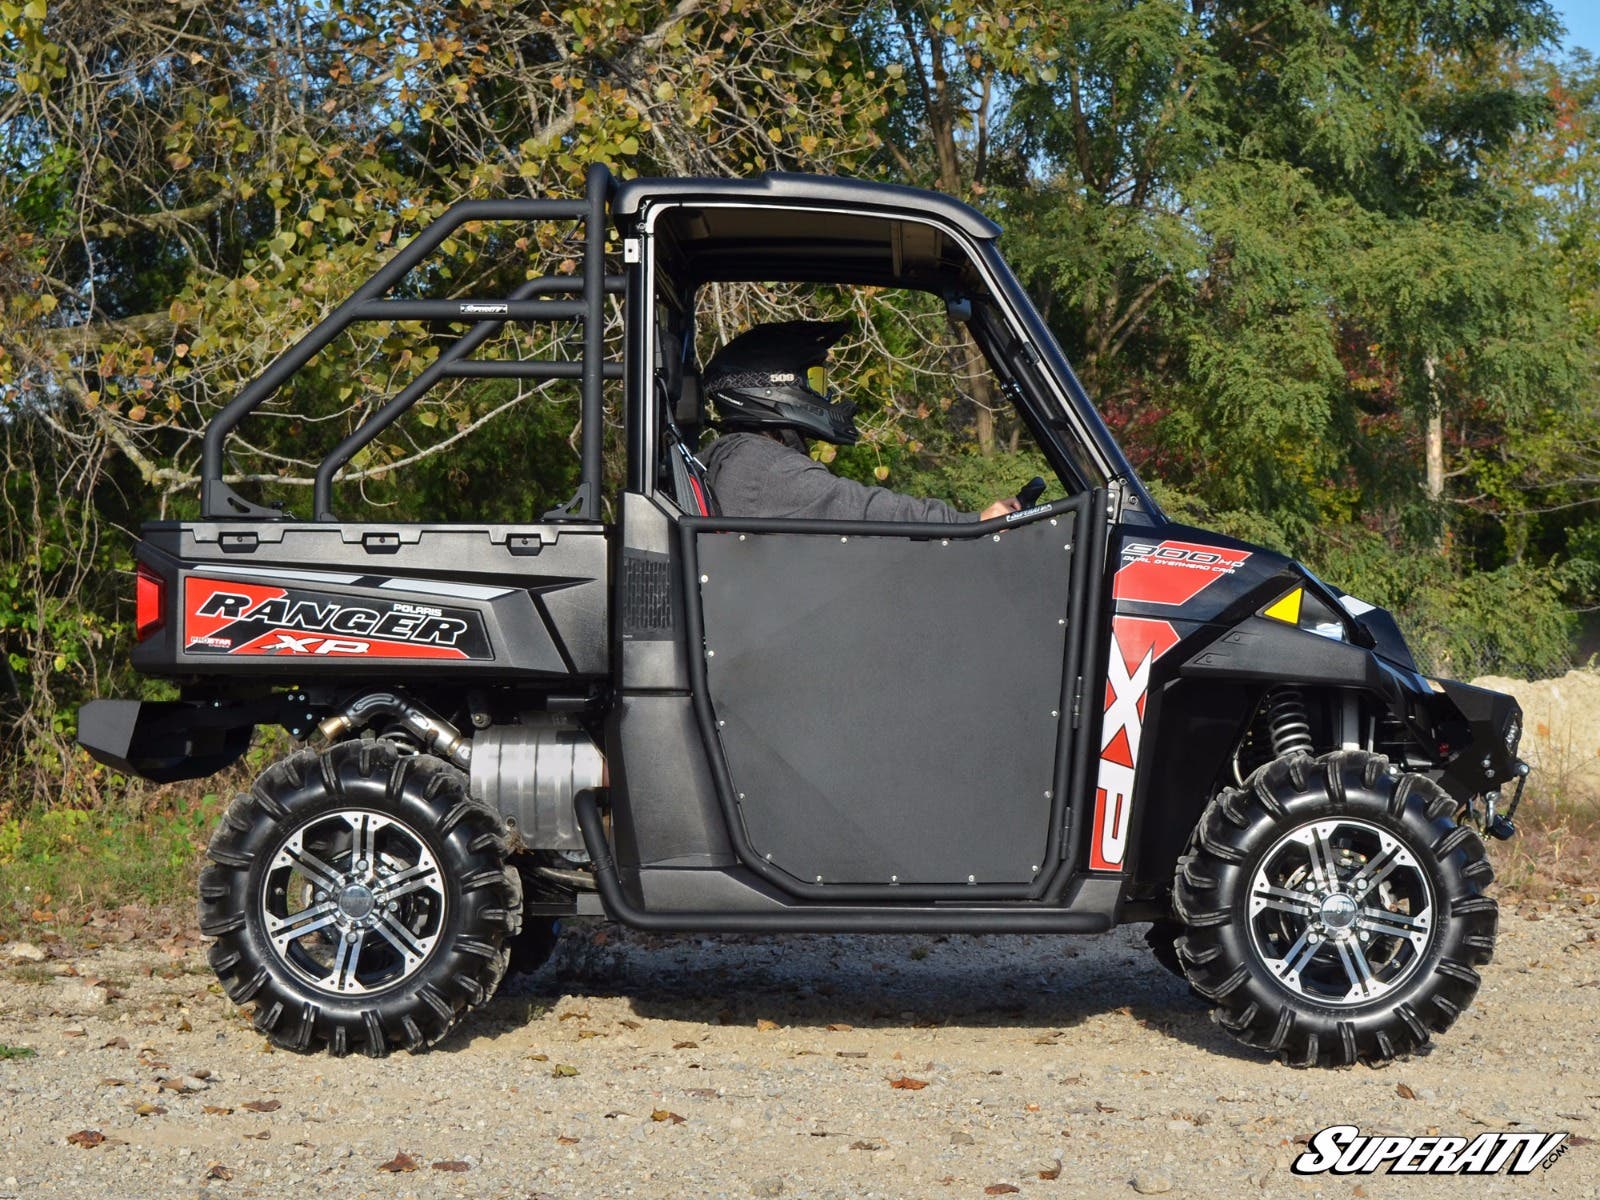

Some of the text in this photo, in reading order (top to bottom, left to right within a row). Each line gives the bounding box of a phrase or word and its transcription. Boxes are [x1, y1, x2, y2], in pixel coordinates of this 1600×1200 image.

[1121, 543, 1221, 564] 900
[1123, 555, 1236, 575] DUAL OVERHEAD CAM
[197, 591, 468, 645] RANGER
[393, 603, 443, 617] POLARIS
[265, 635, 370, 655] XP
[1097, 631, 1155, 865] XP
